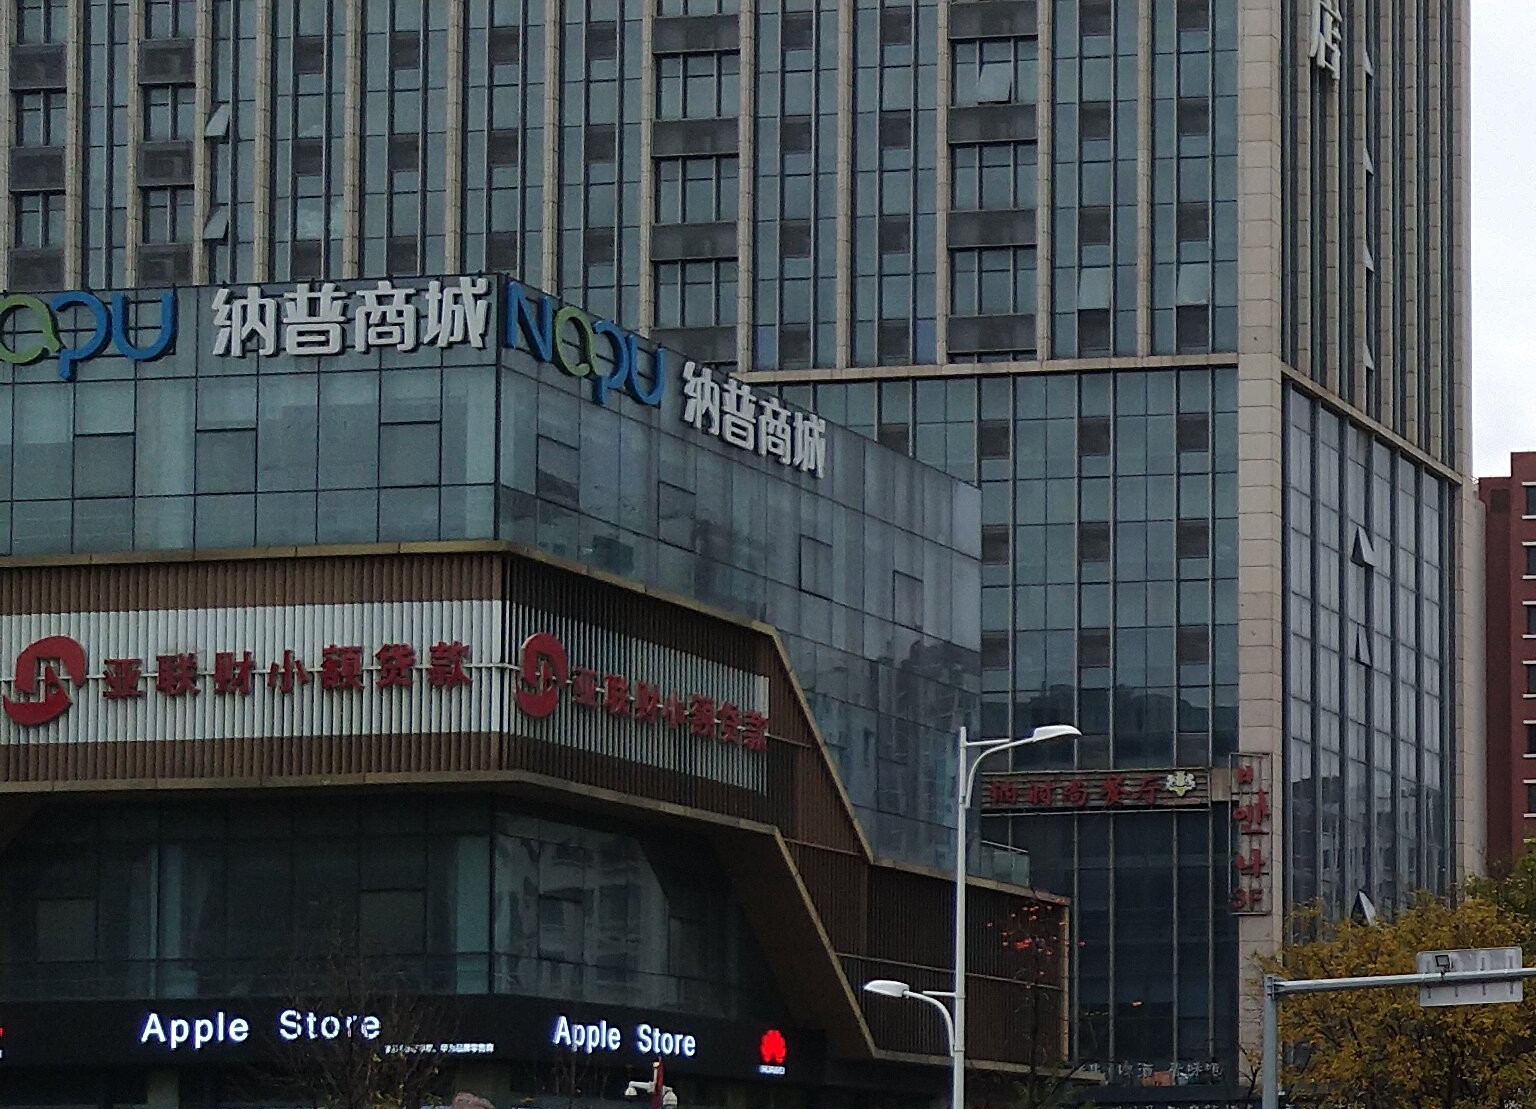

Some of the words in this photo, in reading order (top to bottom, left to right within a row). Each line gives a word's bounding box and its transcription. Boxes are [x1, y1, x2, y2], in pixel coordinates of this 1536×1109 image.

[212, 276, 489, 358] 纳普商城
[682, 361, 826, 479] 纳普商城
[103, 640, 472, 699] 亚联财小额贷款
[141, 1011, 250, 1049] Apple
[279, 1009, 381, 1041] Store
[554, 1015, 621, 1053] Apple
[636, 1023, 696, 1057] Store
